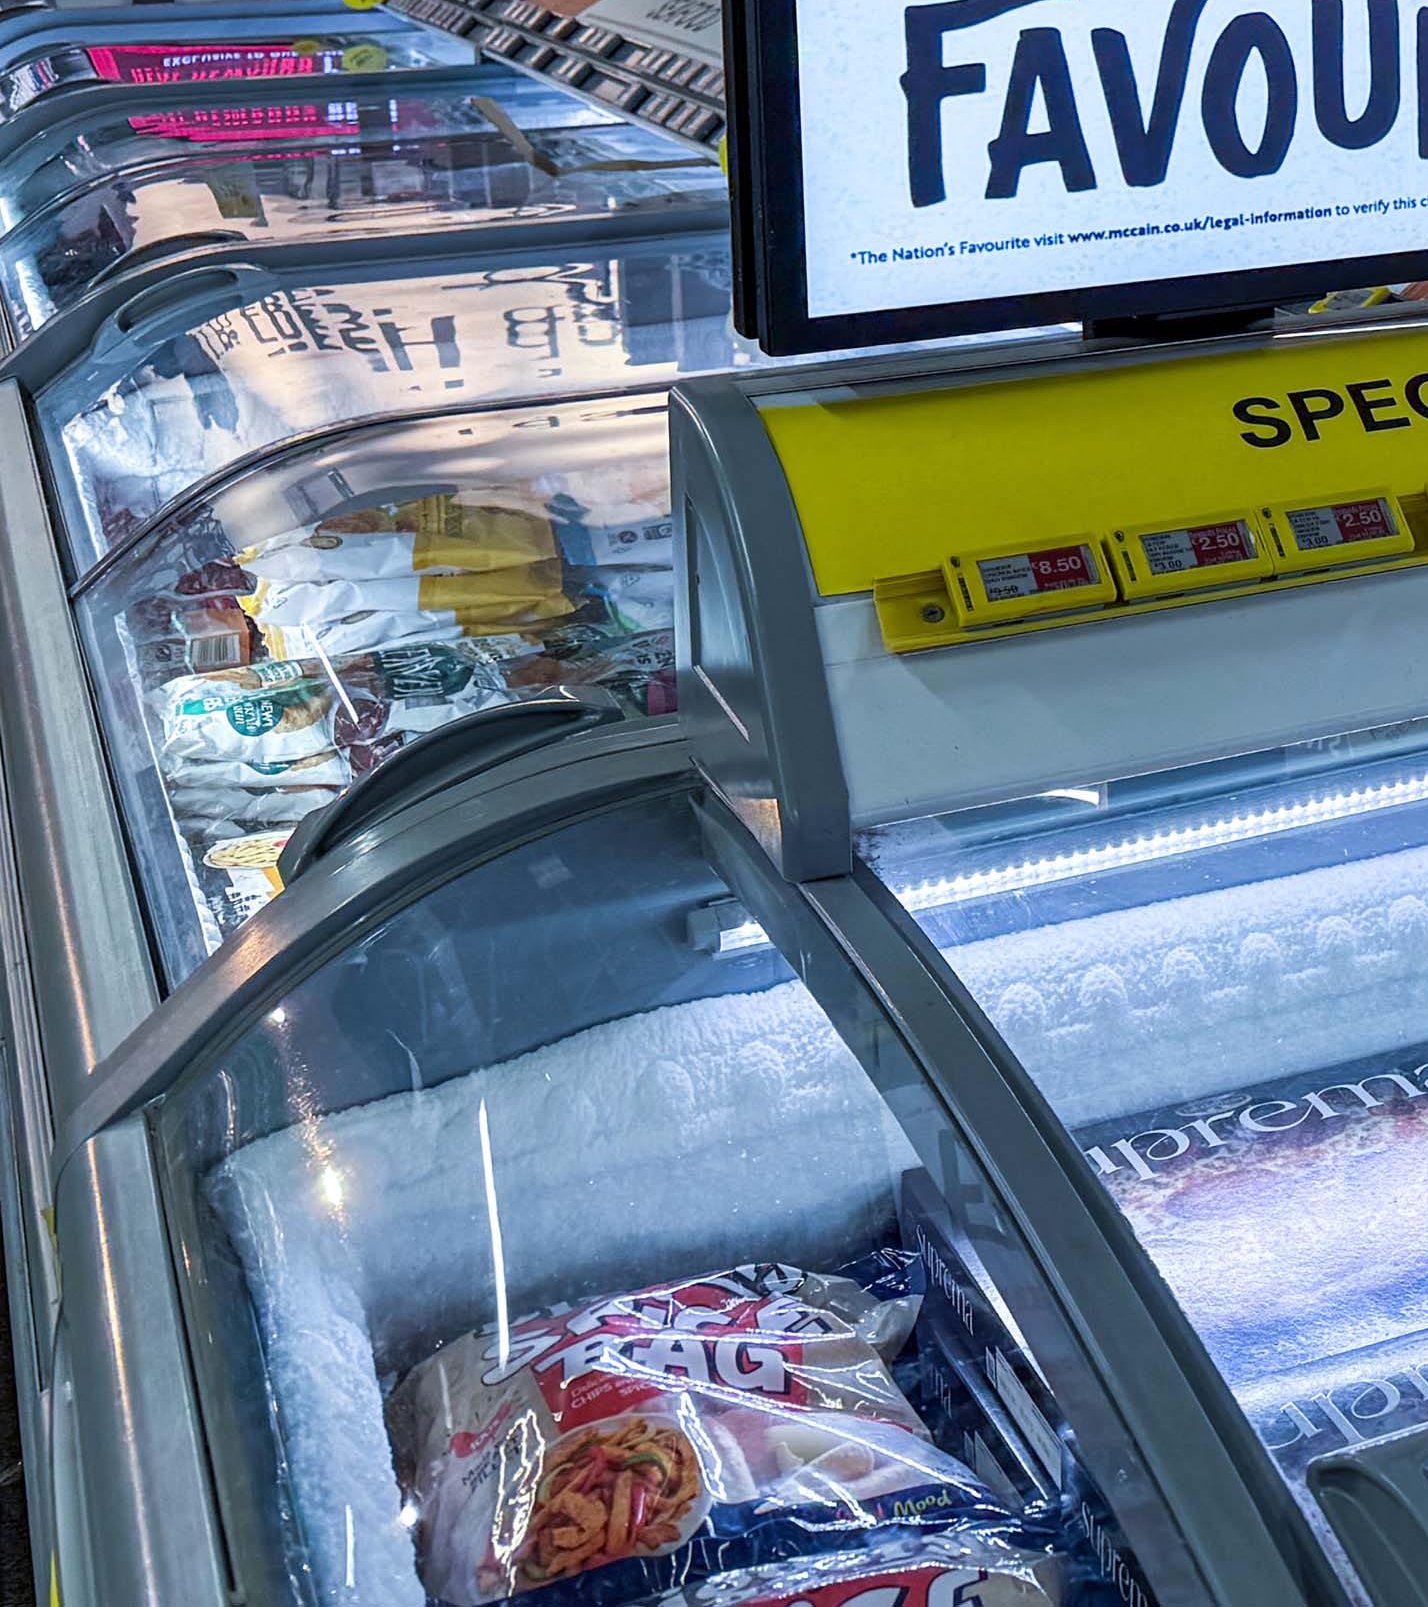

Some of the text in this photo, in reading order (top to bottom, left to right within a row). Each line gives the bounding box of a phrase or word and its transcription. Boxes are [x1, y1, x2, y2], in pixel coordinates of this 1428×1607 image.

[892, 241, 955, 261] Nation's
[960, 235, 1030, 255] Favourite
[1034, 231, 1064, 248] visit
[1336, 205, 1350, 217] to
[1354, 199, 1390, 217] verify
[1392, 195, 1416, 210] this
[916, 1225, 974, 1336] suprema
[893, 1489, 952, 1519] Mood
